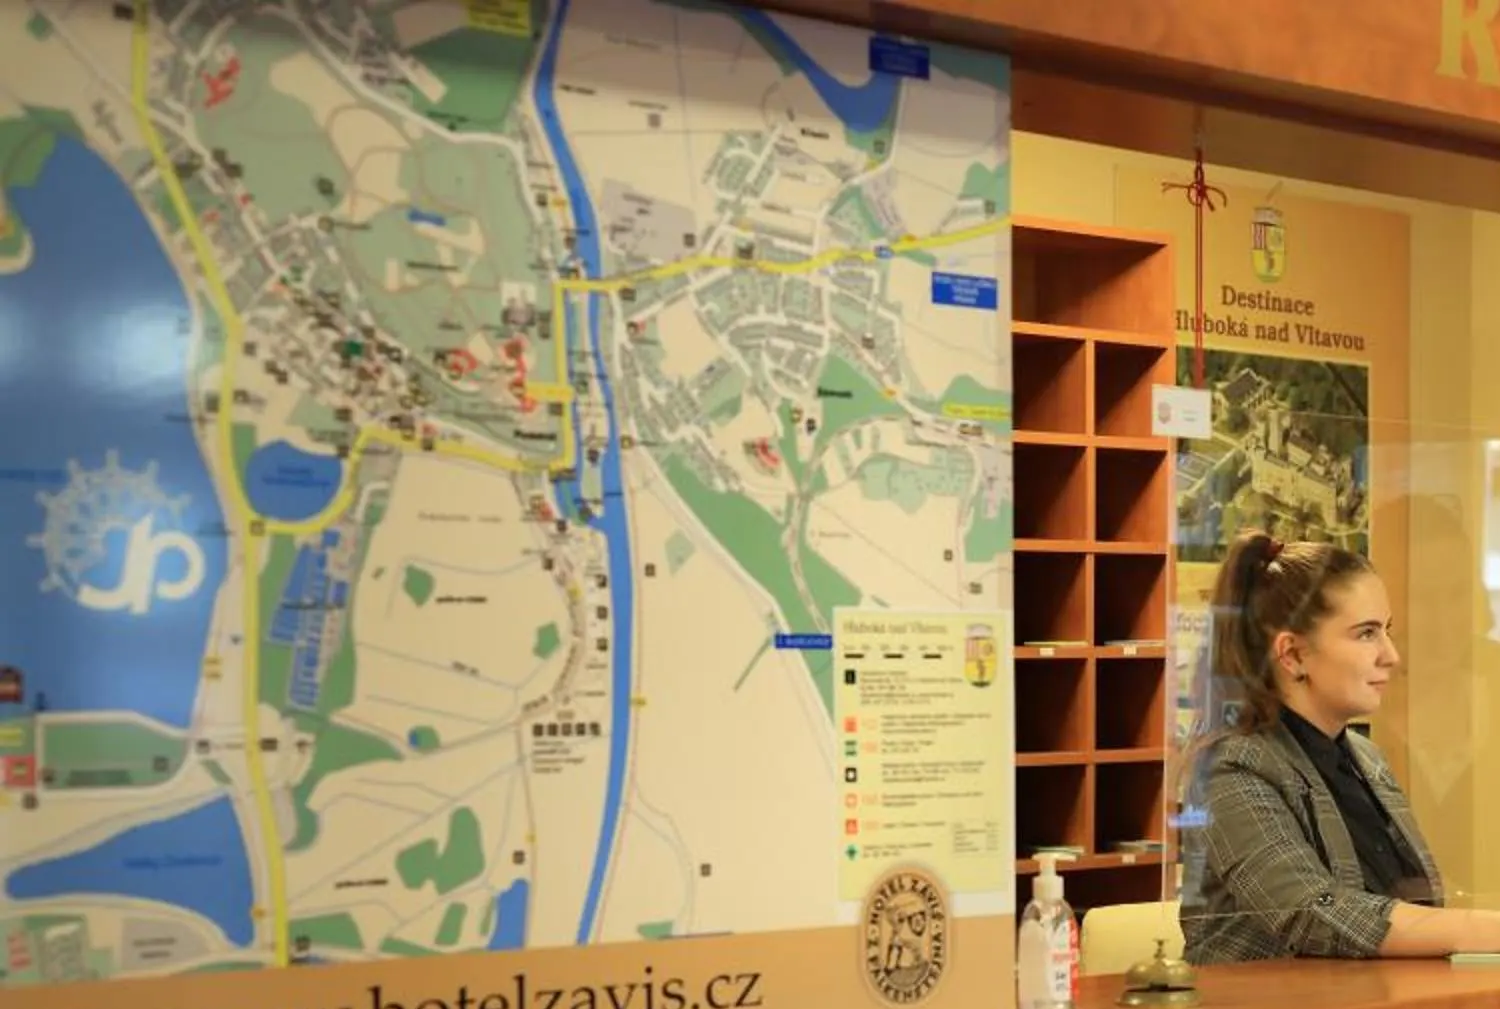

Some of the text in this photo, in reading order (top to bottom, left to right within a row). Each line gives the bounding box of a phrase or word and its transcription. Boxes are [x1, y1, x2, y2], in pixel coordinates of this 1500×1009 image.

[1221, 285, 1315, 316] Destinace
[1255, 322, 1289, 343] nad
[1294, 324, 1366, 351] Vltavou
